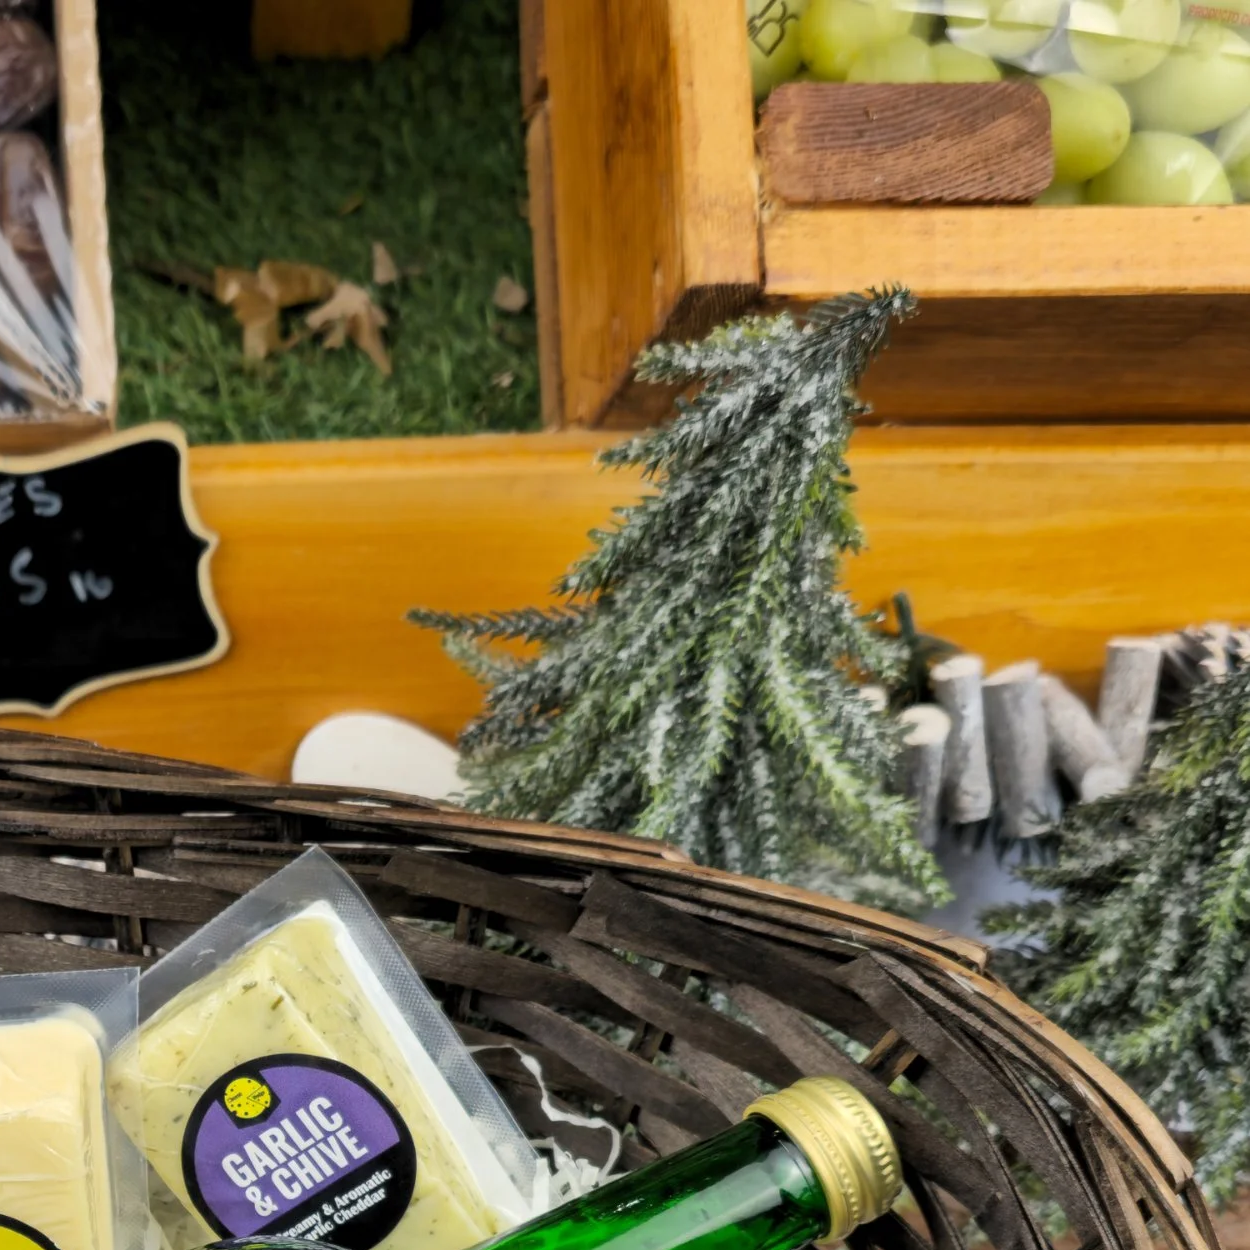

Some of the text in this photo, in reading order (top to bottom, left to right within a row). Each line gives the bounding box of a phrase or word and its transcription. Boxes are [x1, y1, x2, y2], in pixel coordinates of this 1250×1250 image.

[221, 1096, 343, 1188] GARLIC
[245, 1126, 368, 1217] & CHIVE
[322, 1202, 335, 1217] &
[333, 1167, 393, 1207] Aromatic
[333, 1188, 387, 1226] Cheddar
